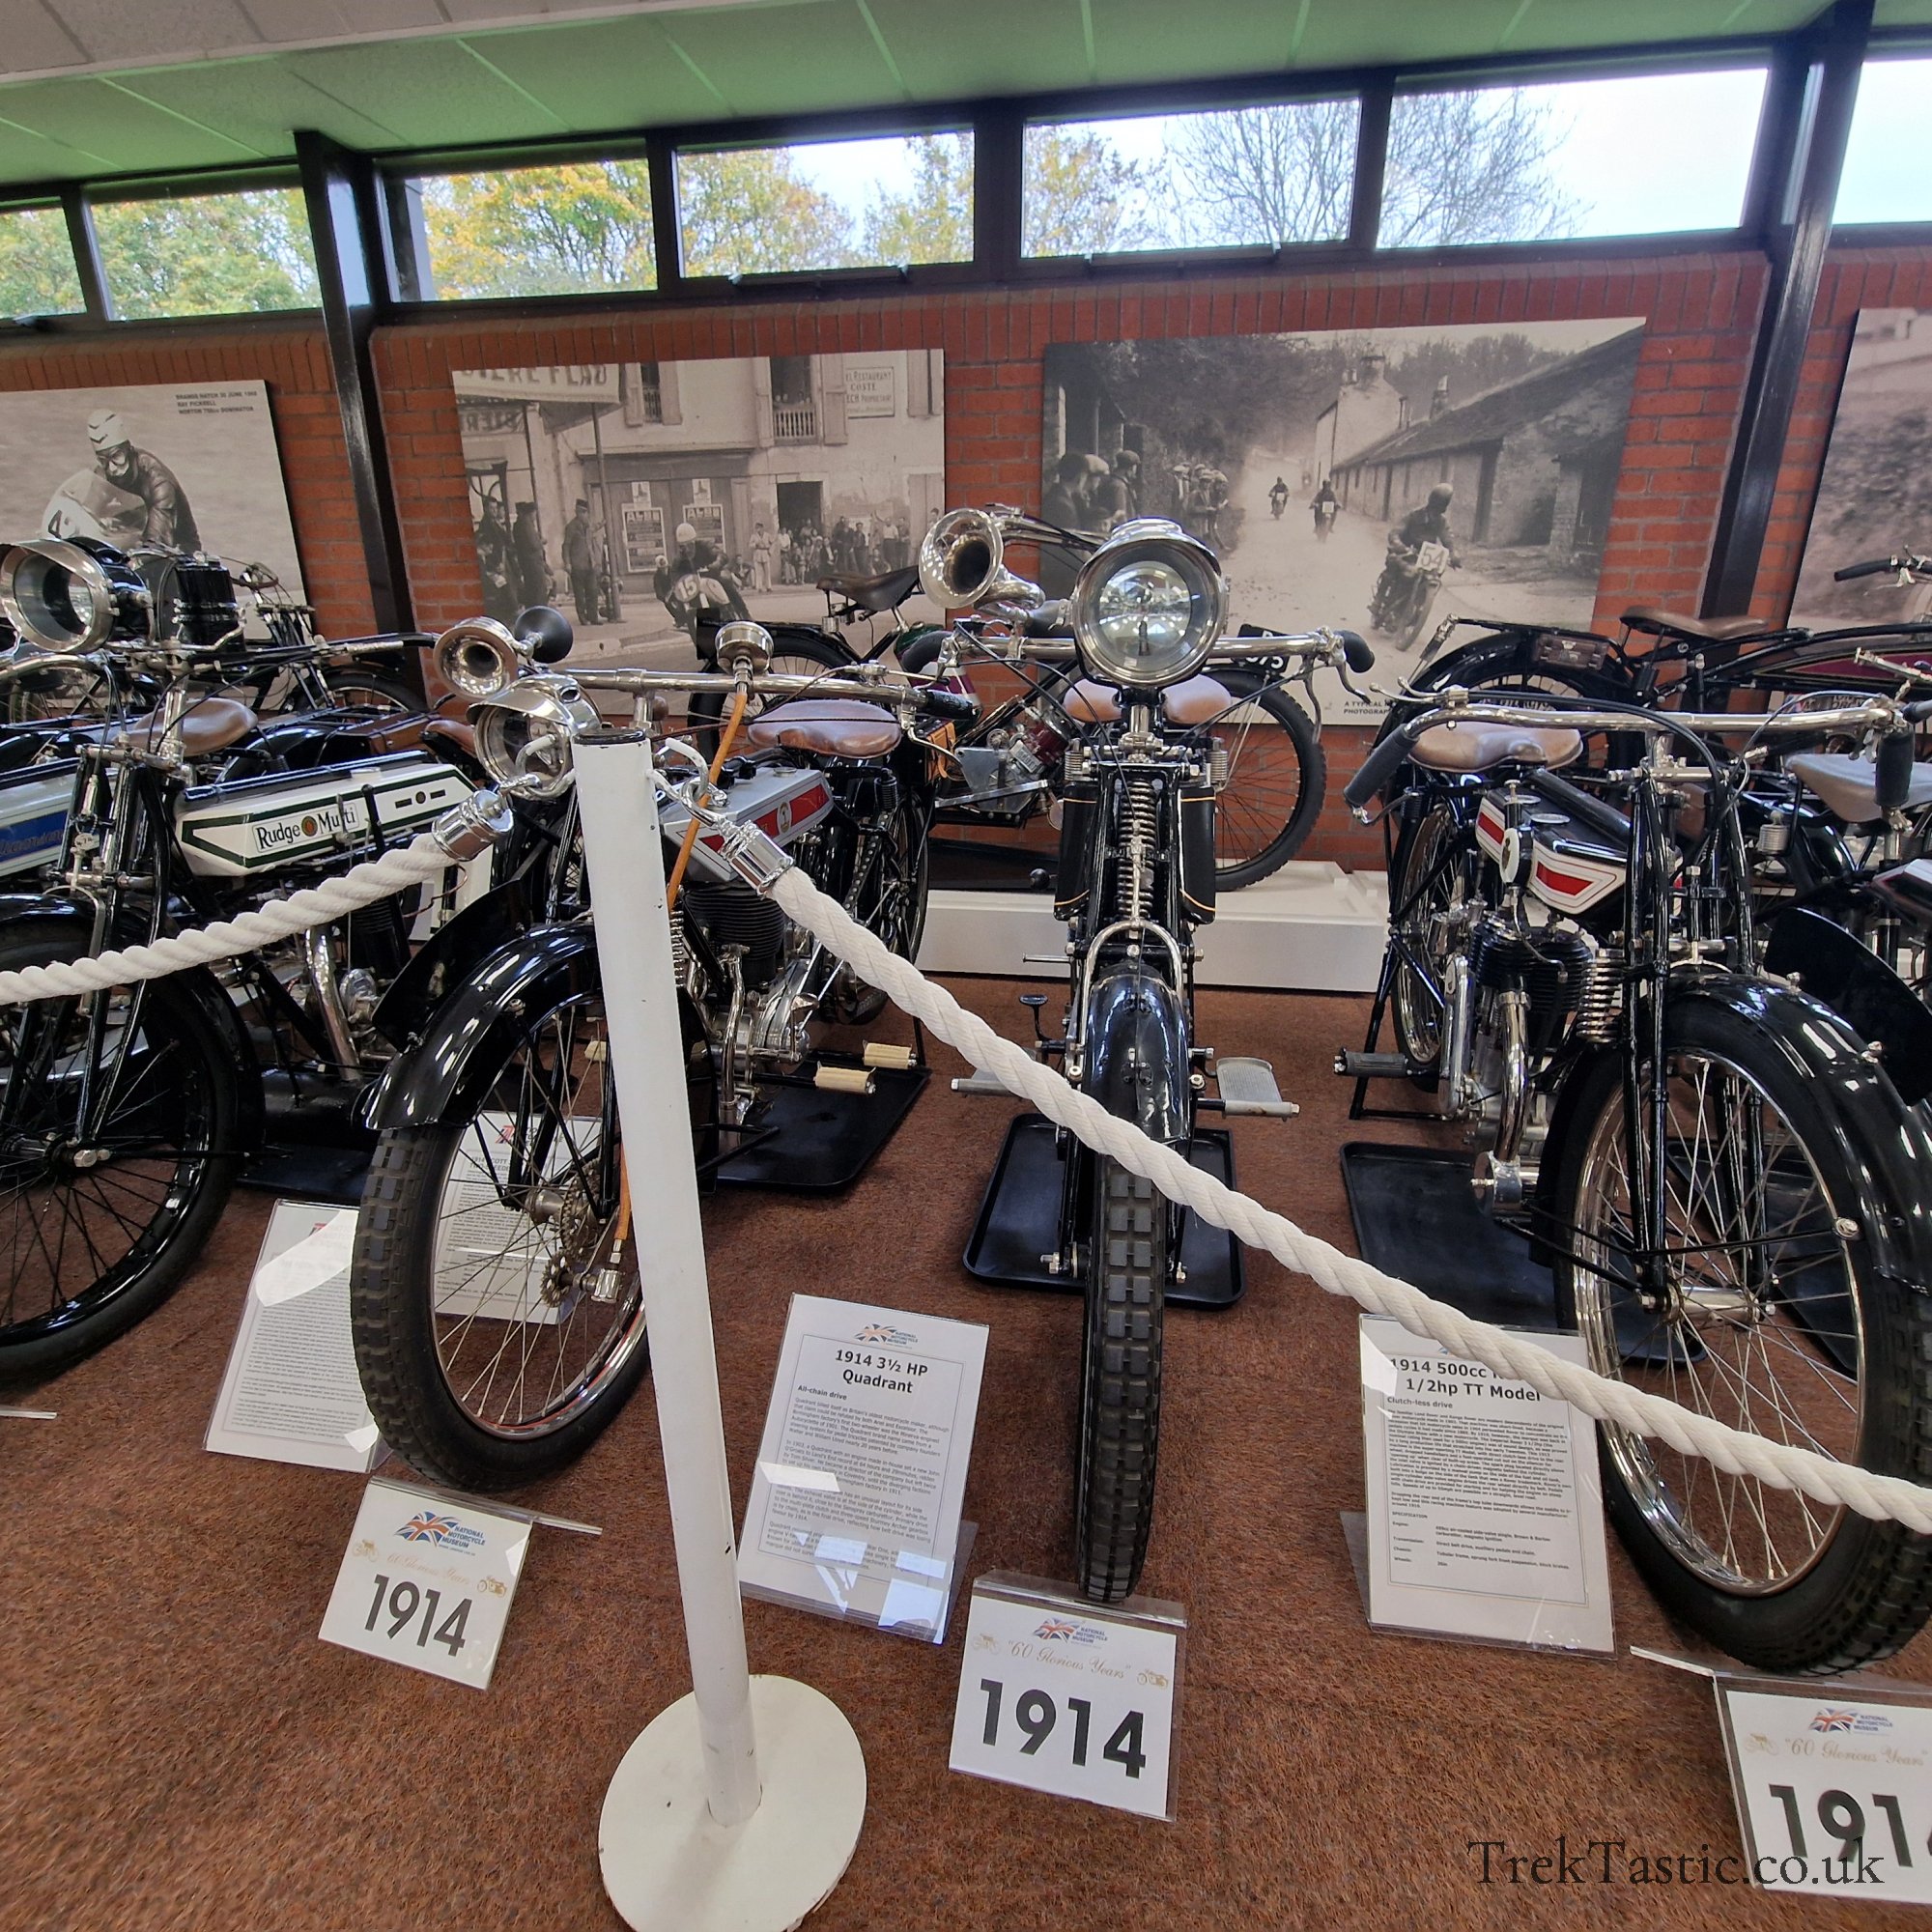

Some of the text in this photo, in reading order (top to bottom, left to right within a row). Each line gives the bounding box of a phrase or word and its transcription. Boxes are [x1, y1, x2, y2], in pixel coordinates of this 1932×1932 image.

[1421, 547, 1444, 568] 54
[677, 577, 697, 599] 15
[255, 806, 356, 849] Rudge Muti
[836, 1350, 873, 1367] 1914
[907, 1363, 928, 1378] HP
[1390, 1358, 1431, 1374] 1914
[1436, 1362, 1487, 1378] 500cc
[842, 1369, 914, 1394] Quadrant
[1406, 1378, 1540, 1401] 1/2hp TT Model
[798, 1385, 847, 1401] All-chain drive
[1387, 1396, 1453, 1409] Clutch-less drive
[441, 1536, 469, 1548] MUSEUM
[447, 1531, 486, 1546] MOTORCYCLE
[454, 1525, 484, 1539] NATIONAL
[364, 1574, 472, 1657] 1914
[1037, 1647, 1084, 1671] Glorious
[980, 1678, 1147, 1779] 1914
[1769, 1783, 1932, 1868] 191
